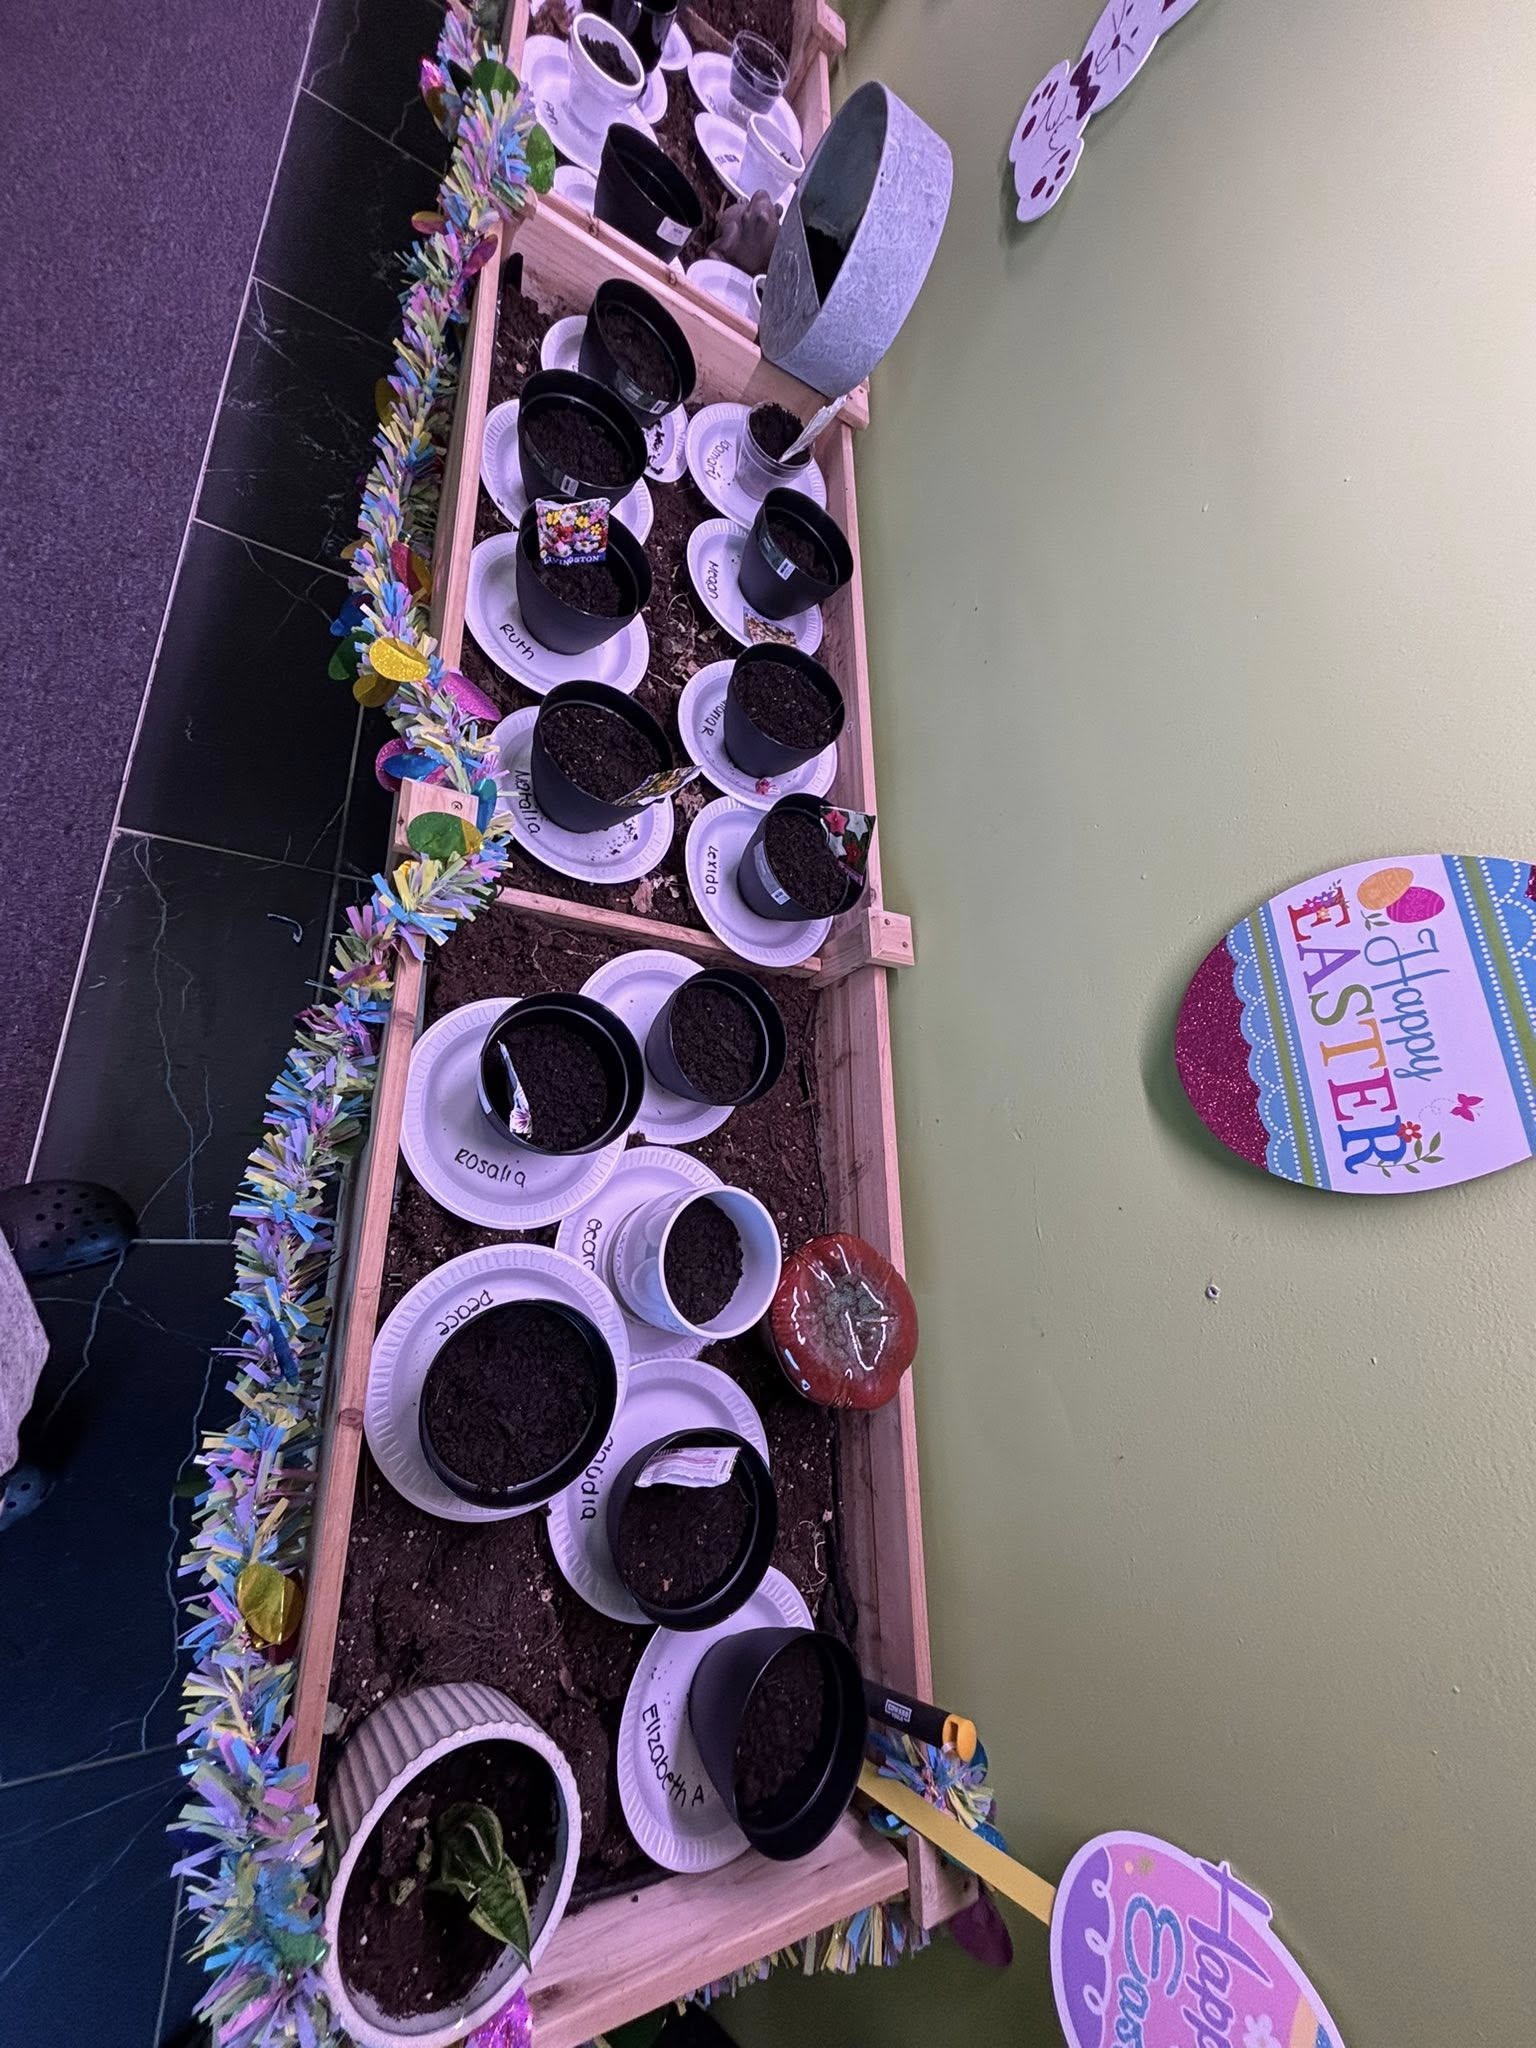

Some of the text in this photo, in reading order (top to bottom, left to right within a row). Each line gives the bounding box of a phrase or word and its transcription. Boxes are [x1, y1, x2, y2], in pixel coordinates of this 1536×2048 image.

[1287, 886, 1407, 1175] EASTER
[1363, 927, 1450, 1082] Happy
[454, 1147, 527, 1189] Rosalia
[642, 1703, 705, 1808] Elizabeth A
